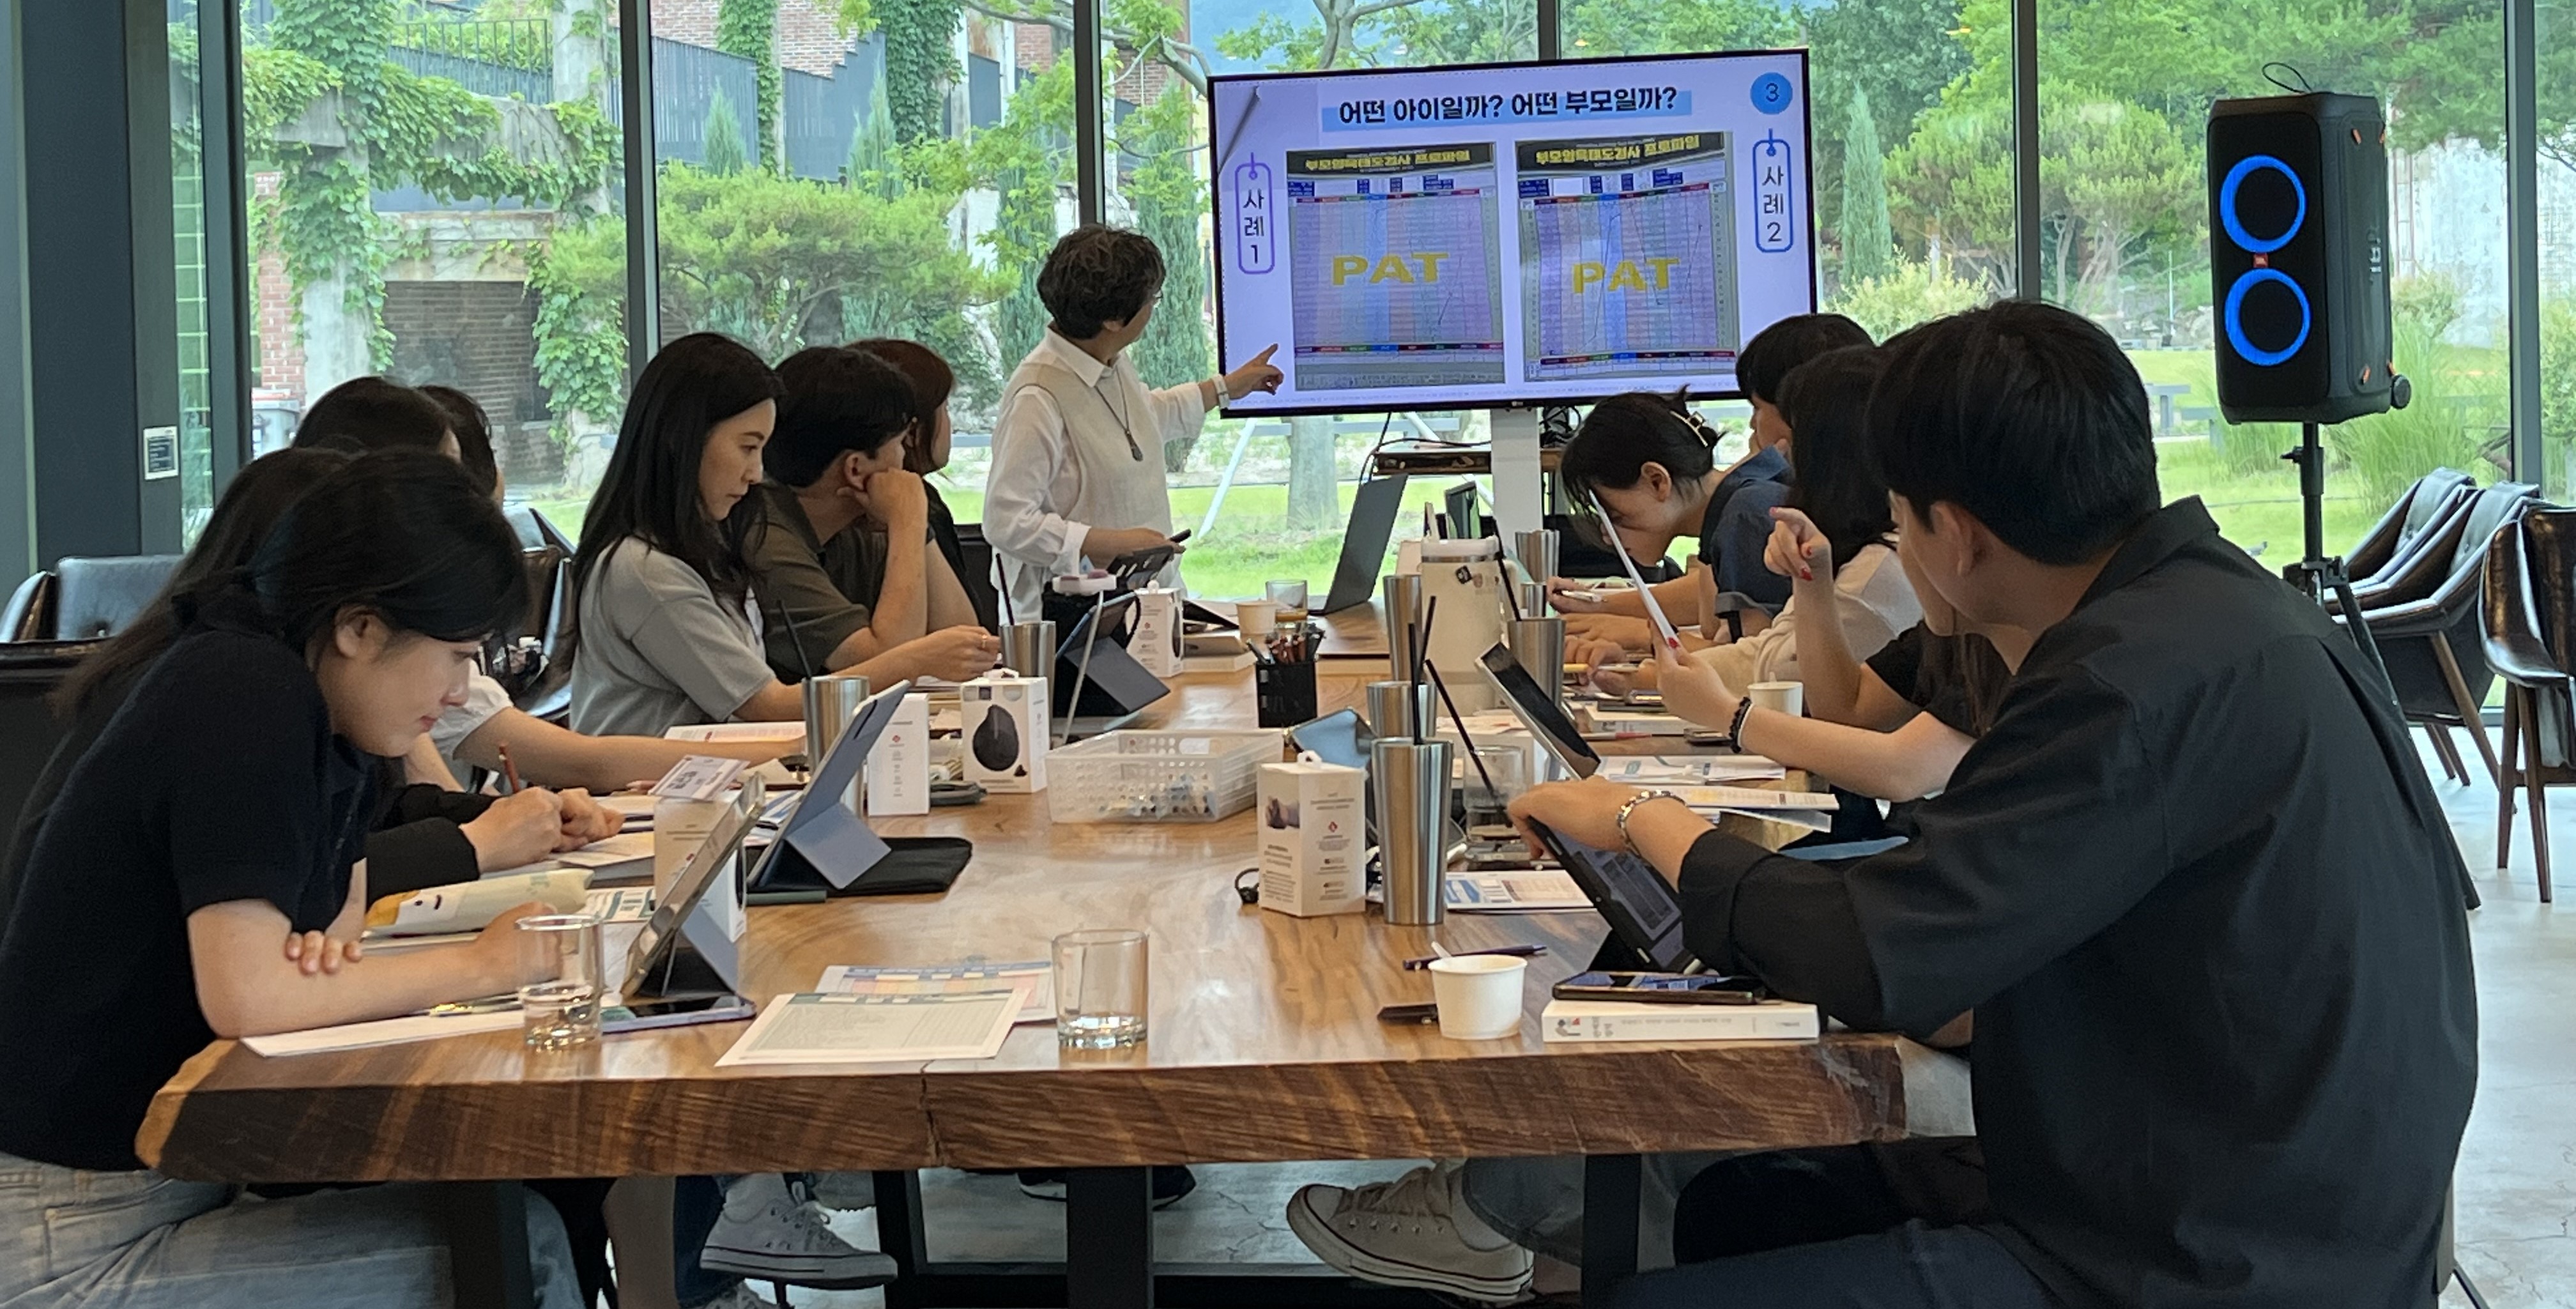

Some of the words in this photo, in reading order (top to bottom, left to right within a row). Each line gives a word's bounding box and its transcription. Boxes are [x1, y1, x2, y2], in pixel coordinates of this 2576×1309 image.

[1339, 100, 1386, 124] 어떤
[1393, 95, 1504, 121] 아이일까?
[1512, 91, 1558, 116] 어떤
[1565, 86, 1677, 114] 부모일까?
[1765, 82, 1779, 102] 3
[1762, 165, 1784, 215] 사례
[1243, 188, 1264, 237] 사례
[1767, 222, 1782, 241] 2
[1250, 244, 1259, 264] 1
[1333, 252, 1449, 285] PAT
[1573, 258, 1680, 294] PAT
